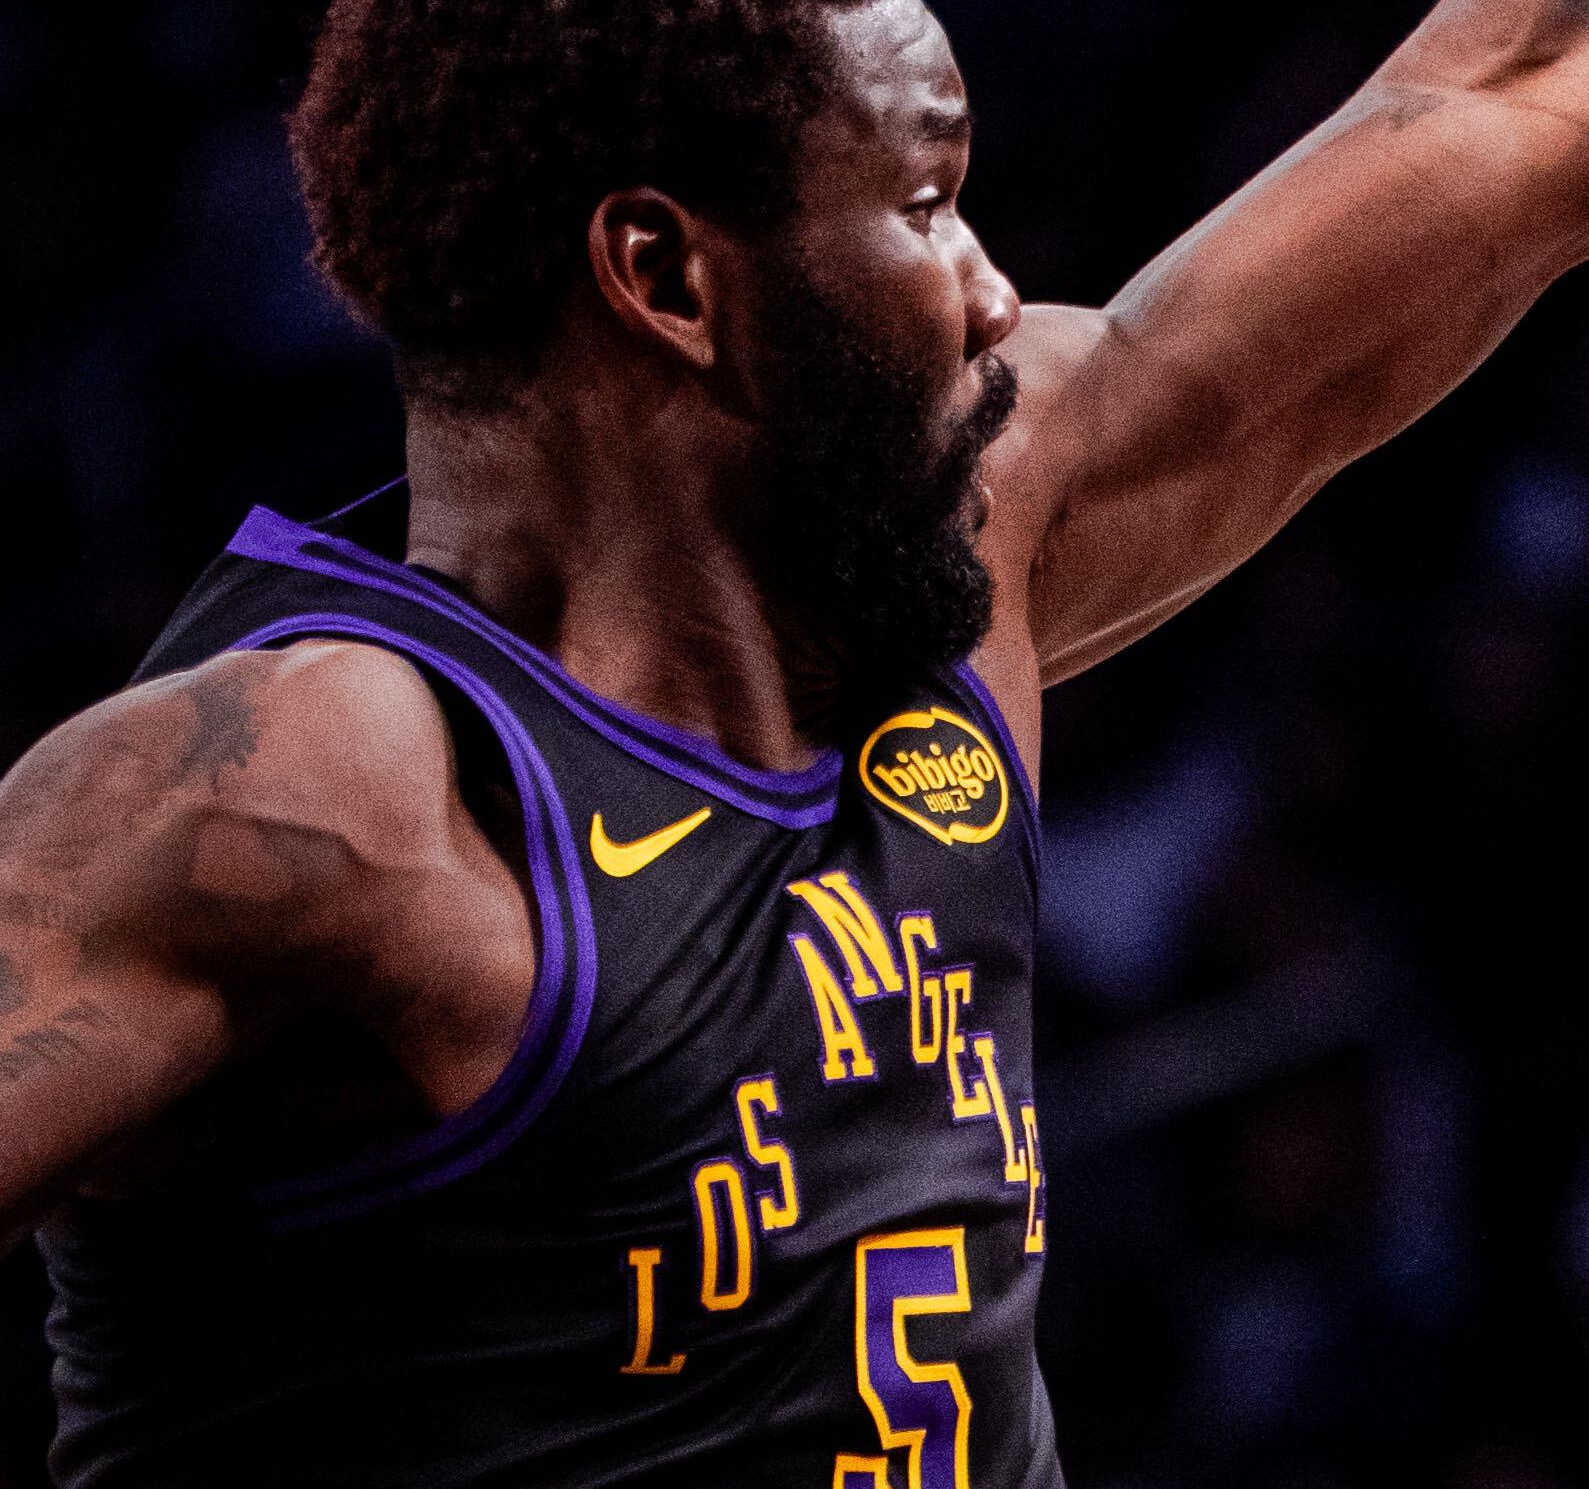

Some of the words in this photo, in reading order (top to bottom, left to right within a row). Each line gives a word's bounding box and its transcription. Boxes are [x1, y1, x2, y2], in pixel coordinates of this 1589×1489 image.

[872, 742, 996, 800] bibigo
[922, 787, 972, 815] 비비고
[620, 1070, 802, 1376] LOS
